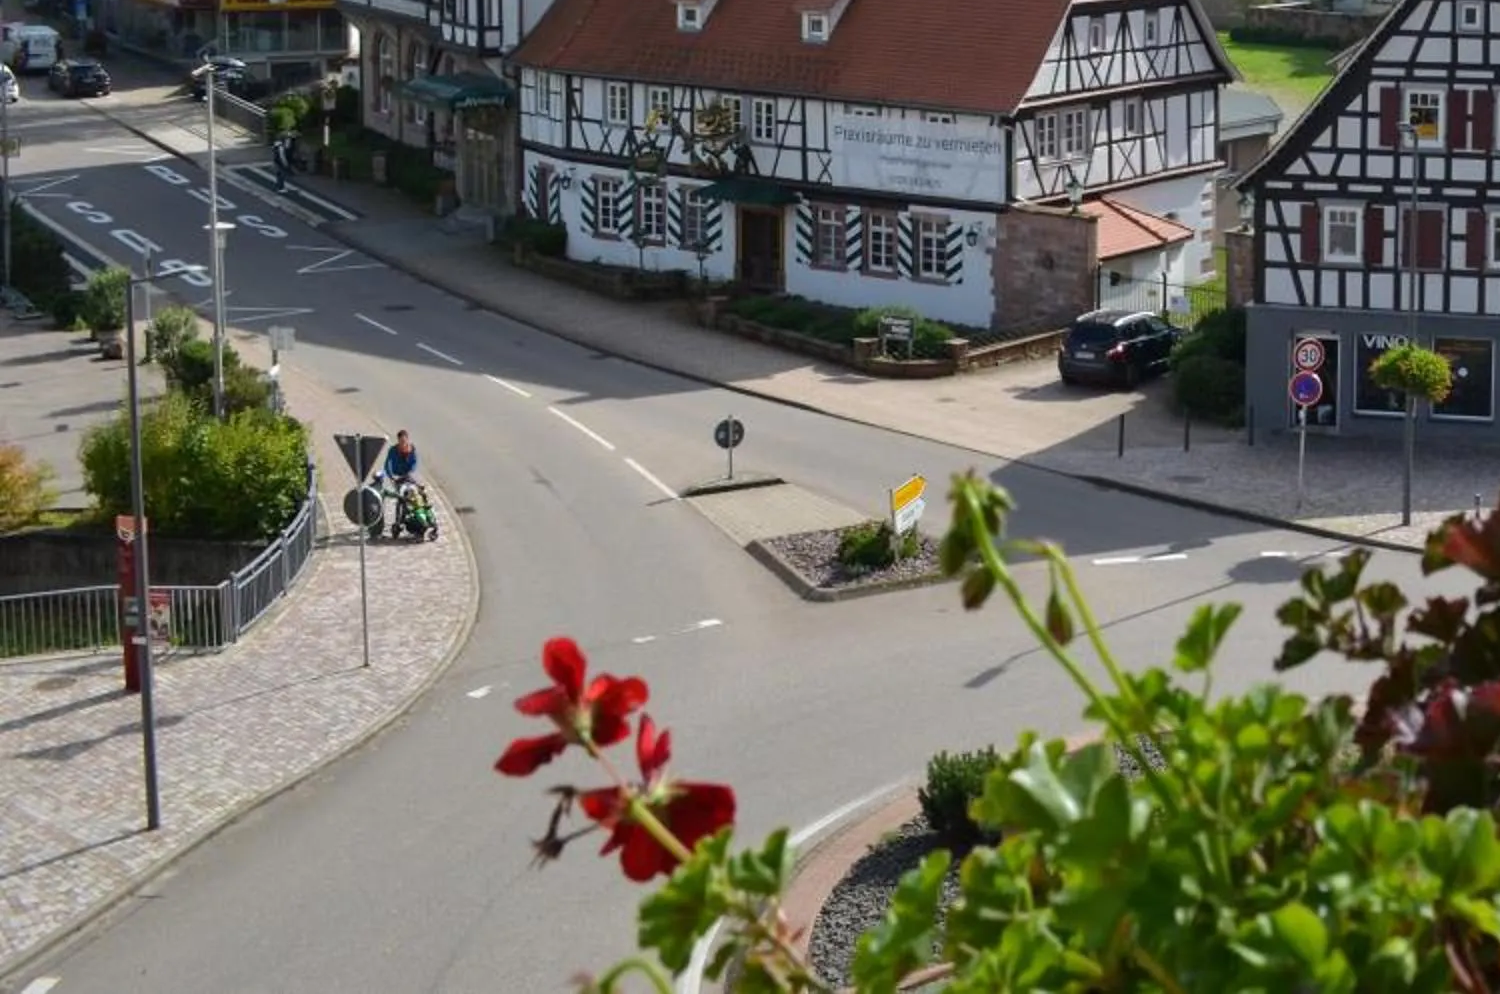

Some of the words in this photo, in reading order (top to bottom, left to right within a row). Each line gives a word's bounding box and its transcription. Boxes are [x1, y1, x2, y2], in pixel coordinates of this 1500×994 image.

[916, 135, 931, 149] zu
[1362, 333, 1409, 350] VINO
[1301, 348, 1317, 363] 30
